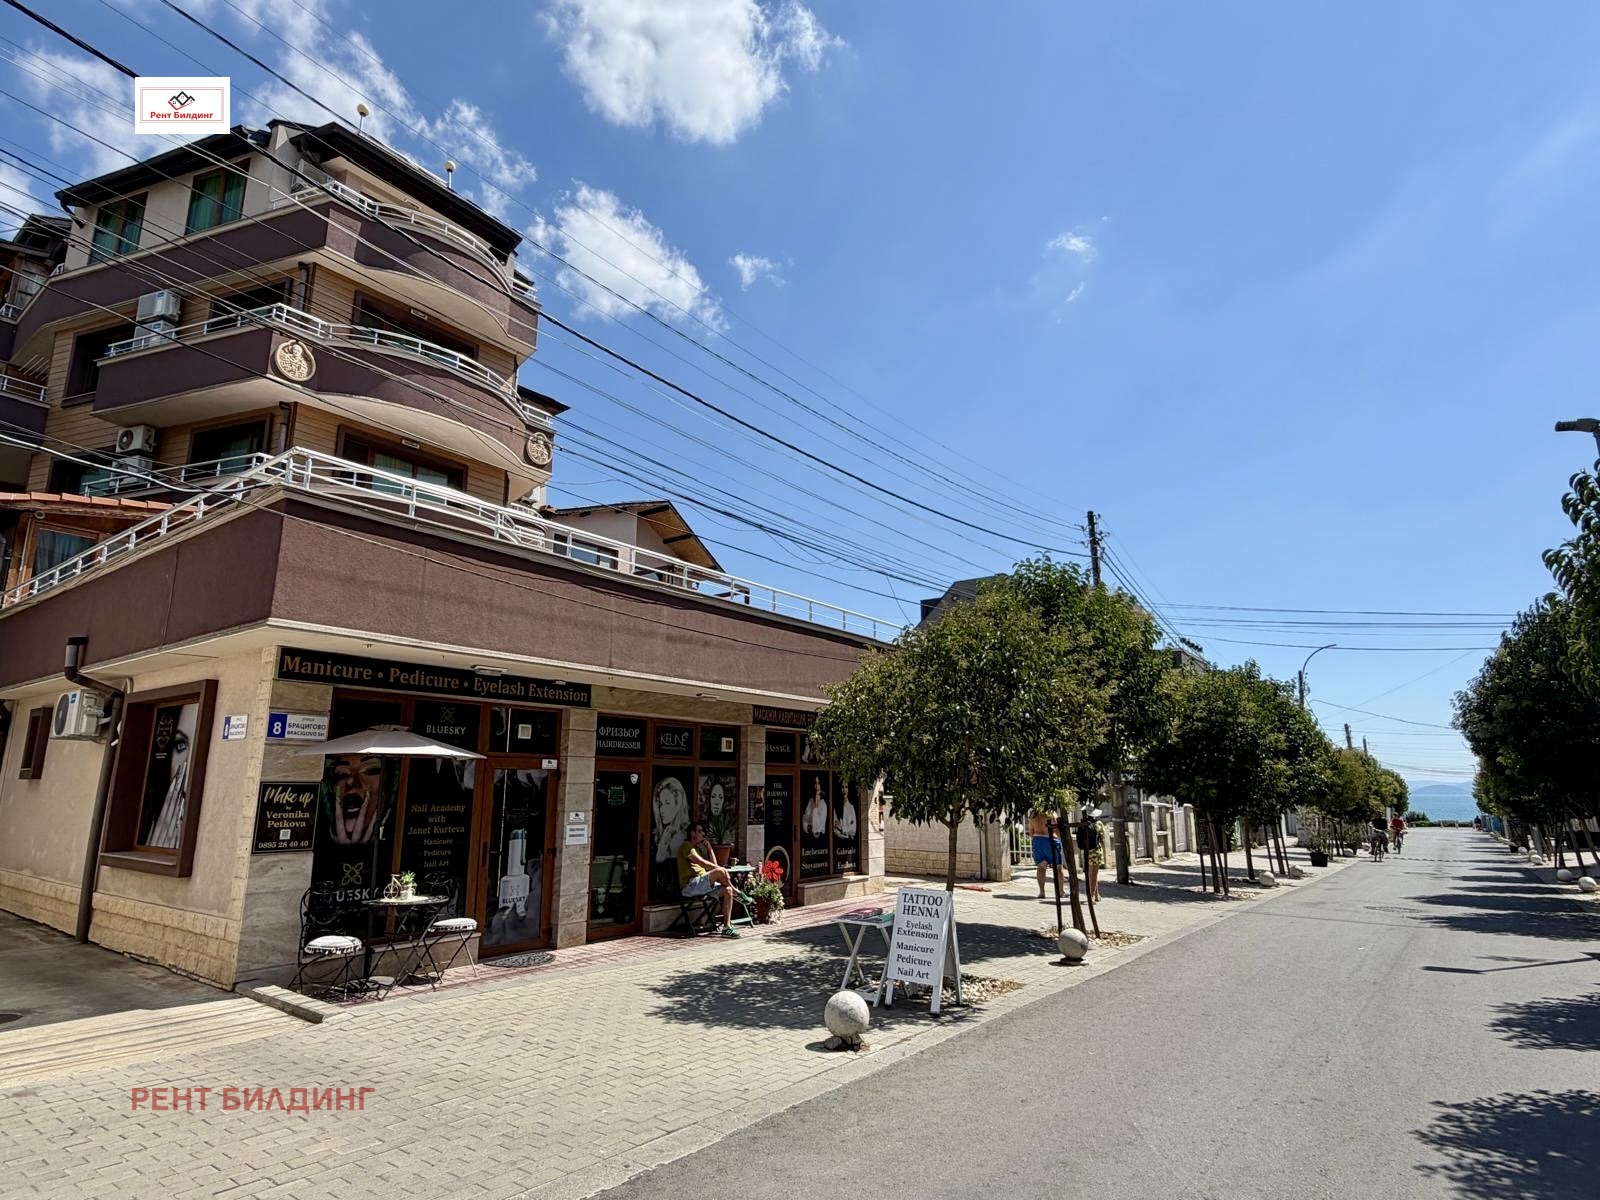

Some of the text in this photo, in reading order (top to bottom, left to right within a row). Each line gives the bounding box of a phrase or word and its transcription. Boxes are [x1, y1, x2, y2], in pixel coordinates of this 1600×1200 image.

[282, 655, 588, 703] Manicure Pedicure Eyelash Extension
[272, 721, 282, 735] 8
[288, 722, 327, 731] БРАЦИГОВО
[426, 724, 467, 735] BLUESKY
[599, 726, 640, 738] ФРИЗЬОР
[597, 739, 641, 750] HAIRDRESSER
[263, 786, 314, 808] Make up
[411, 804, 466, 813] Nail Academy
[266, 810, 310, 819] Veronika
[428, 814, 446, 823] with
[267, 820, 306, 828] Petkova
[408, 825, 465, 835] Janet Kurteva
[258, 841, 277, 849] 0895
[902, 892, 943, 907] TATTOO
[902, 905, 940, 919] HENNA
[906, 920, 933, 931] Eyelash
[896, 927, 939, 940] Extension
[896, 941, 935, 954] Manicure
[896, 953, 932, 967] Pedicure
[897, 967, 929, 980] Nail Art
